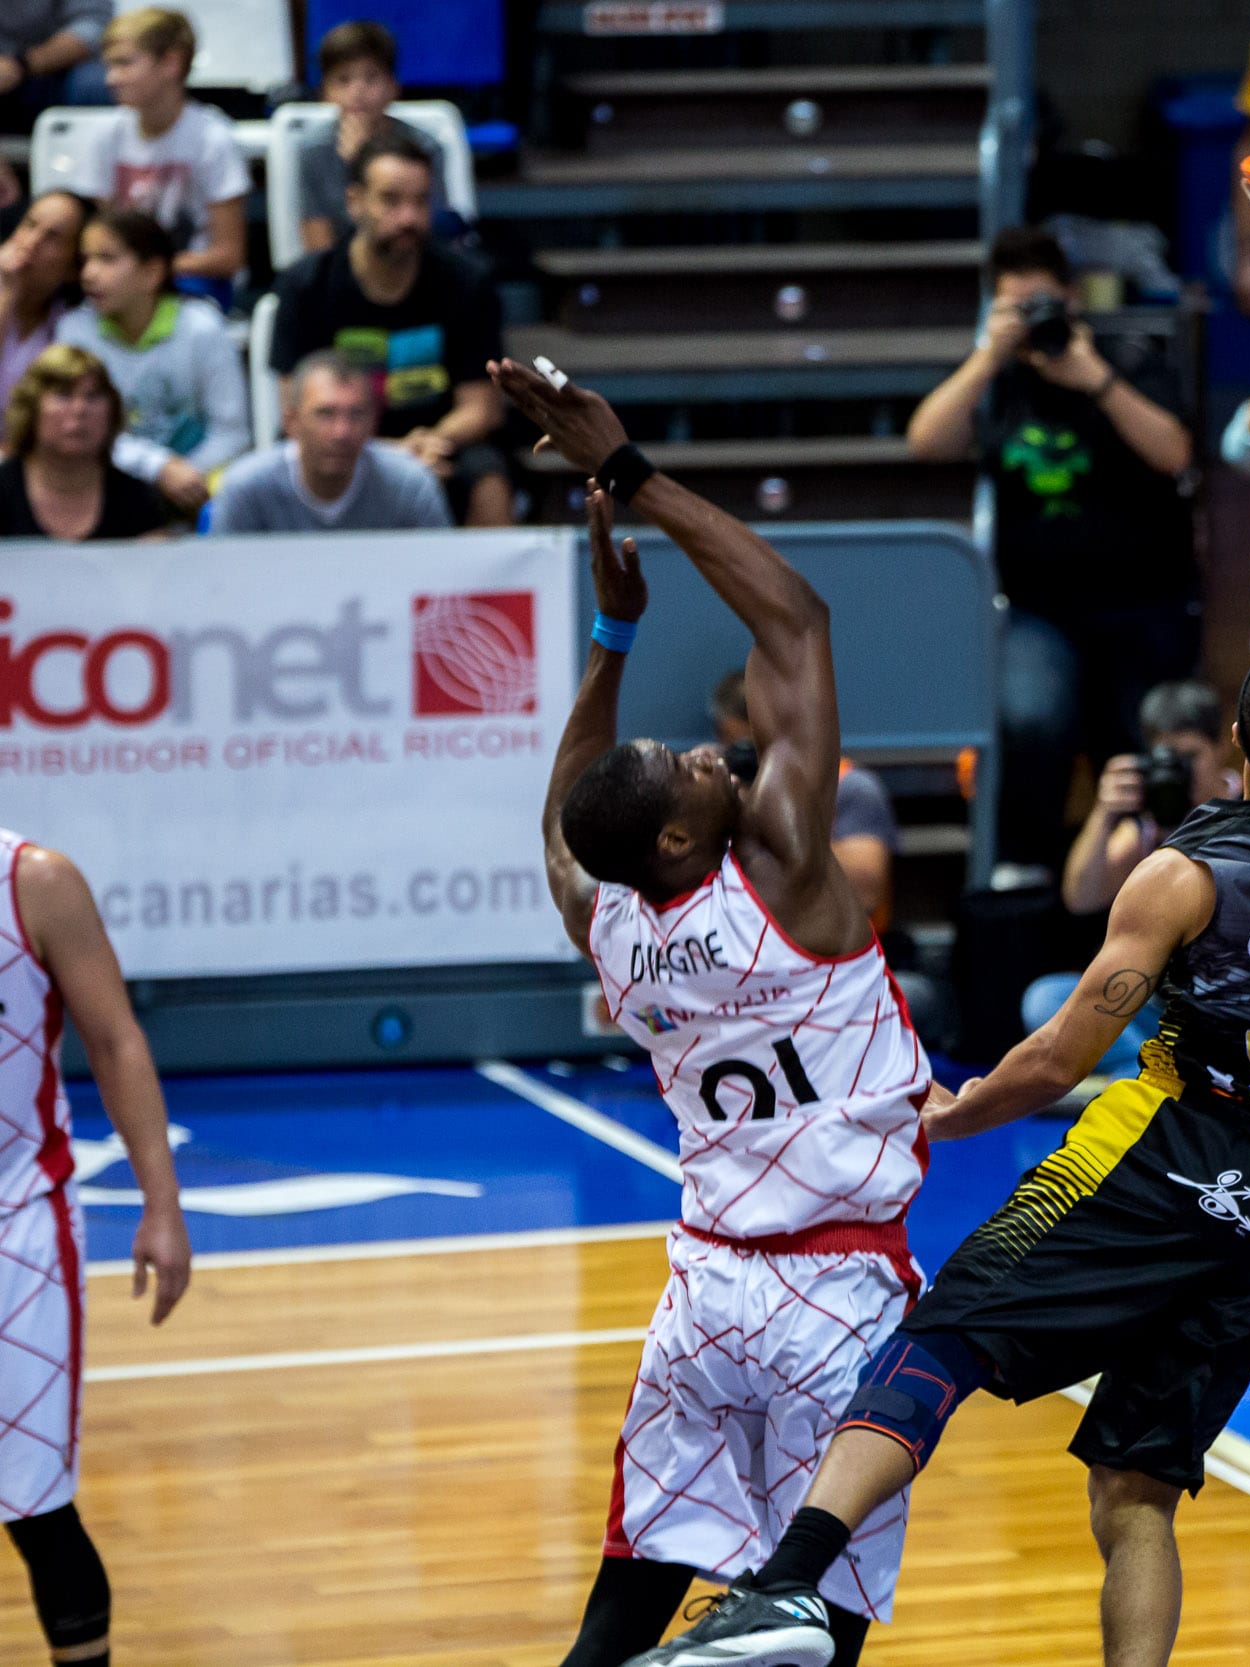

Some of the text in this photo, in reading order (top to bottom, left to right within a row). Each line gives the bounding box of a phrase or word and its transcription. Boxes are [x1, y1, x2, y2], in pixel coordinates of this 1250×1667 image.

[222, 730, 390, 771] OFICIAL
[404, 724, 541, 762] RICOH
[630, 929, 729, 984] DIAGNE
